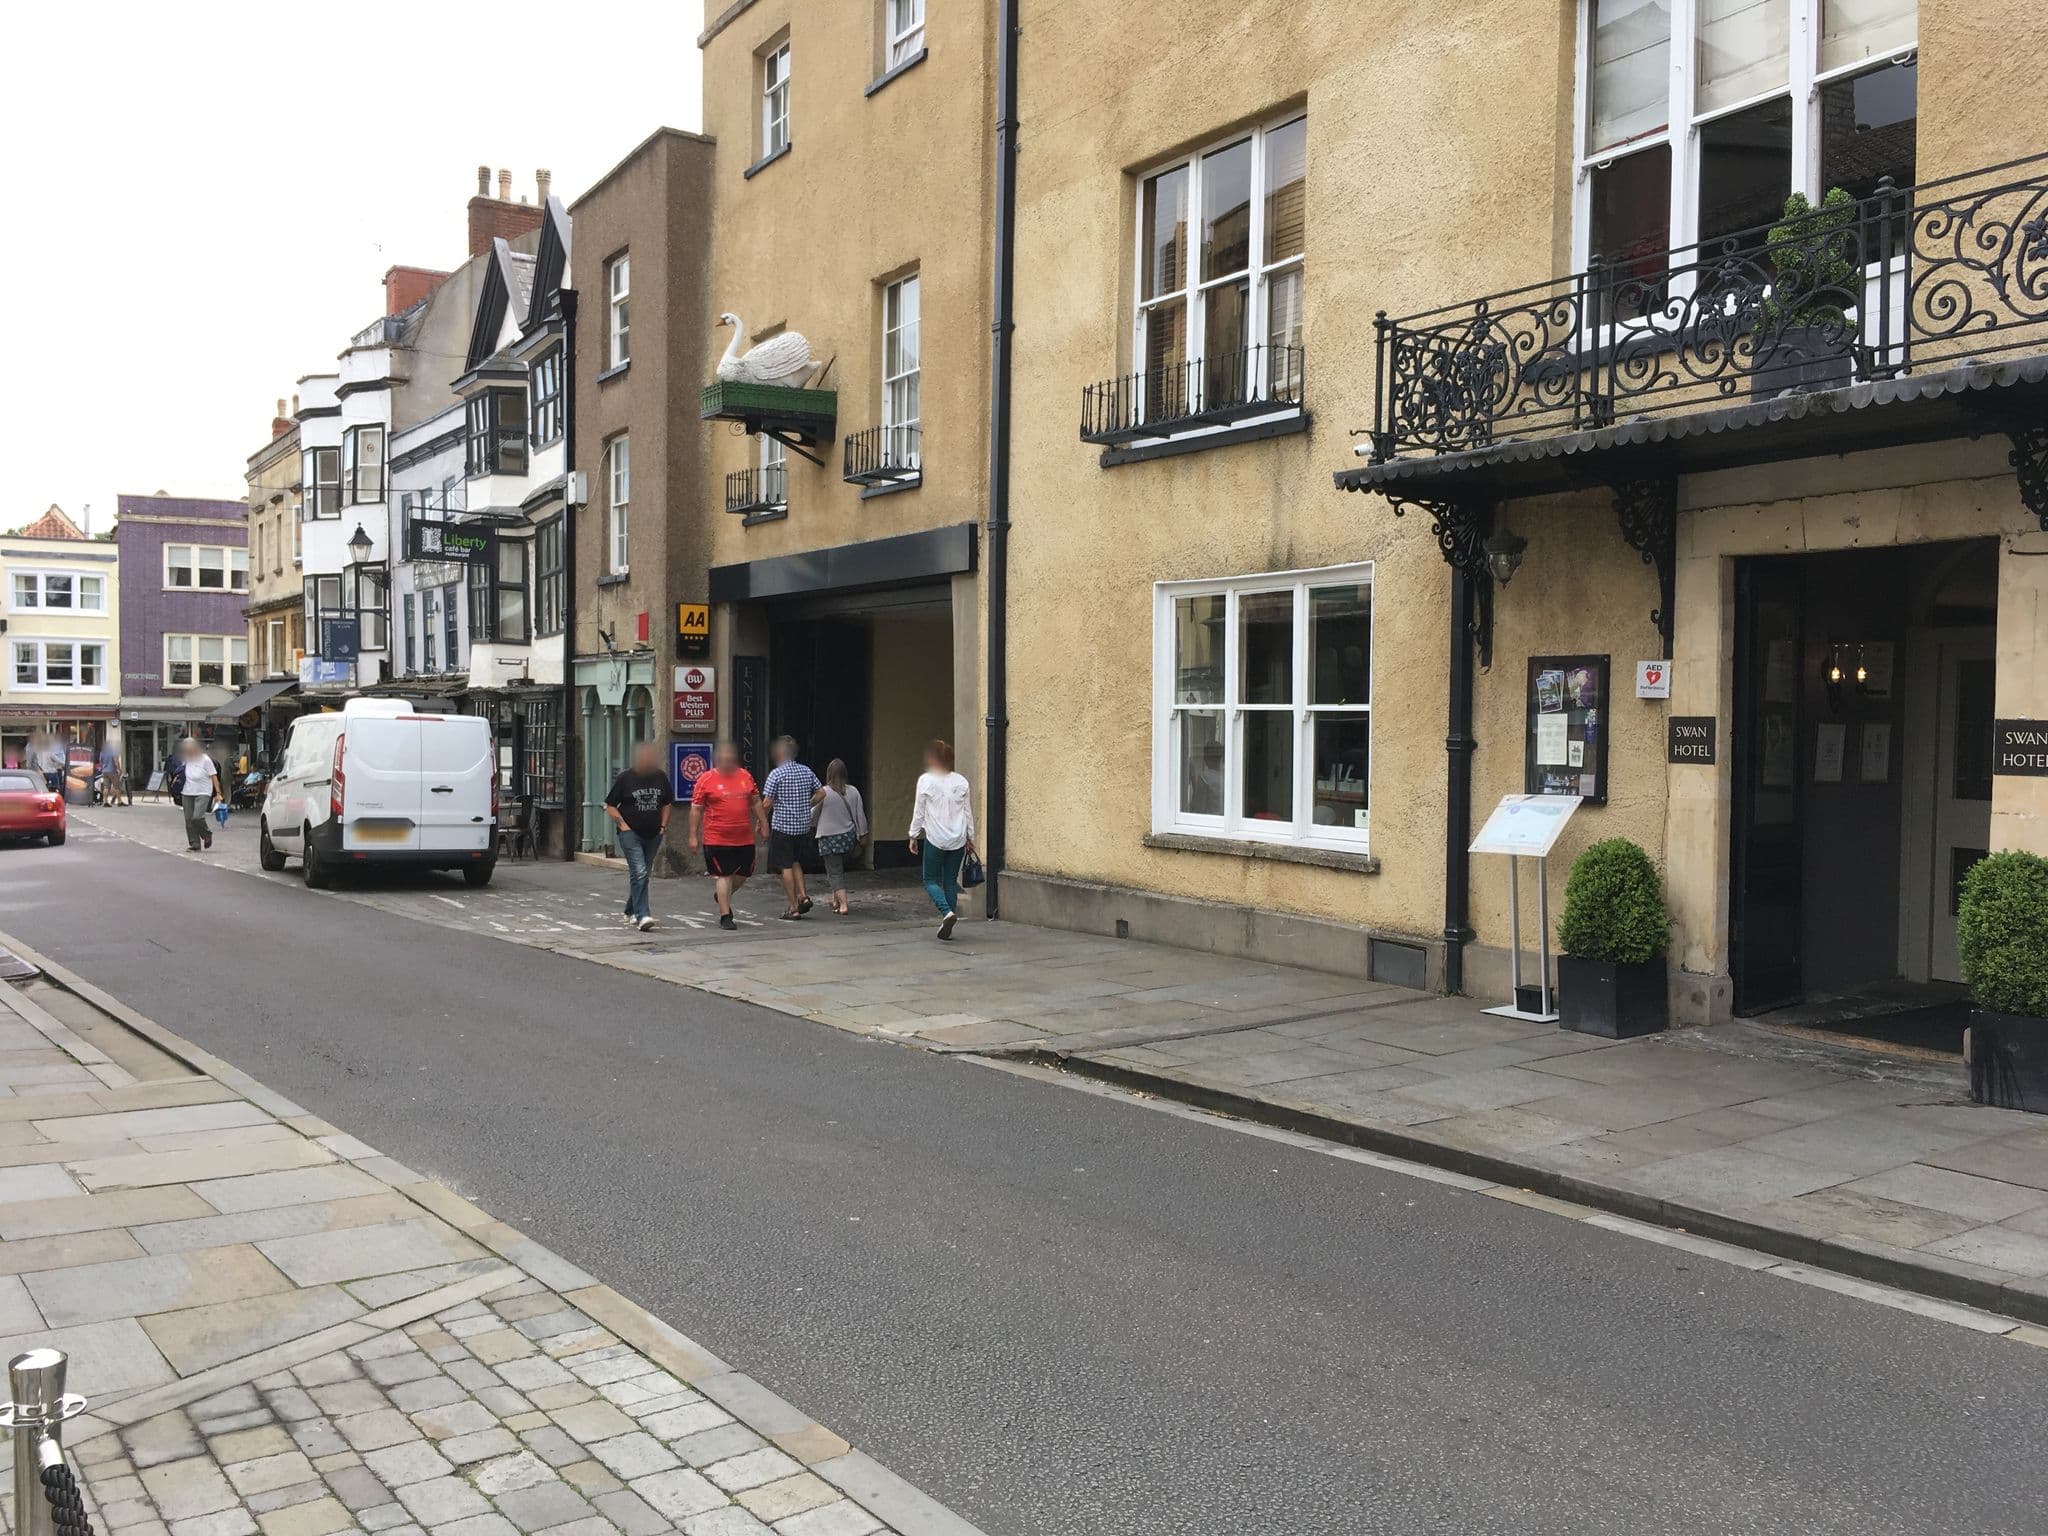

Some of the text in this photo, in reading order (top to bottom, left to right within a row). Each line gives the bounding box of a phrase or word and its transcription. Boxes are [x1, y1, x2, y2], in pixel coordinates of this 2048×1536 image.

[444, 533, 487, 550] Liberty
[444, 545, 460, 553] café
[684, 611, 705, 627] AA
[687, 675, 703, 683] BW
[680, 701, 710, 709] Western
[743, 664, 752, 769] ENTRANC
[1676, 726, 1707, 738] SWAN
[2005, 731, 2048, 745] SWAN
[1674, 744, 1711, 757] HOTEL
[2003, 753, 2048, 768] HOTE
